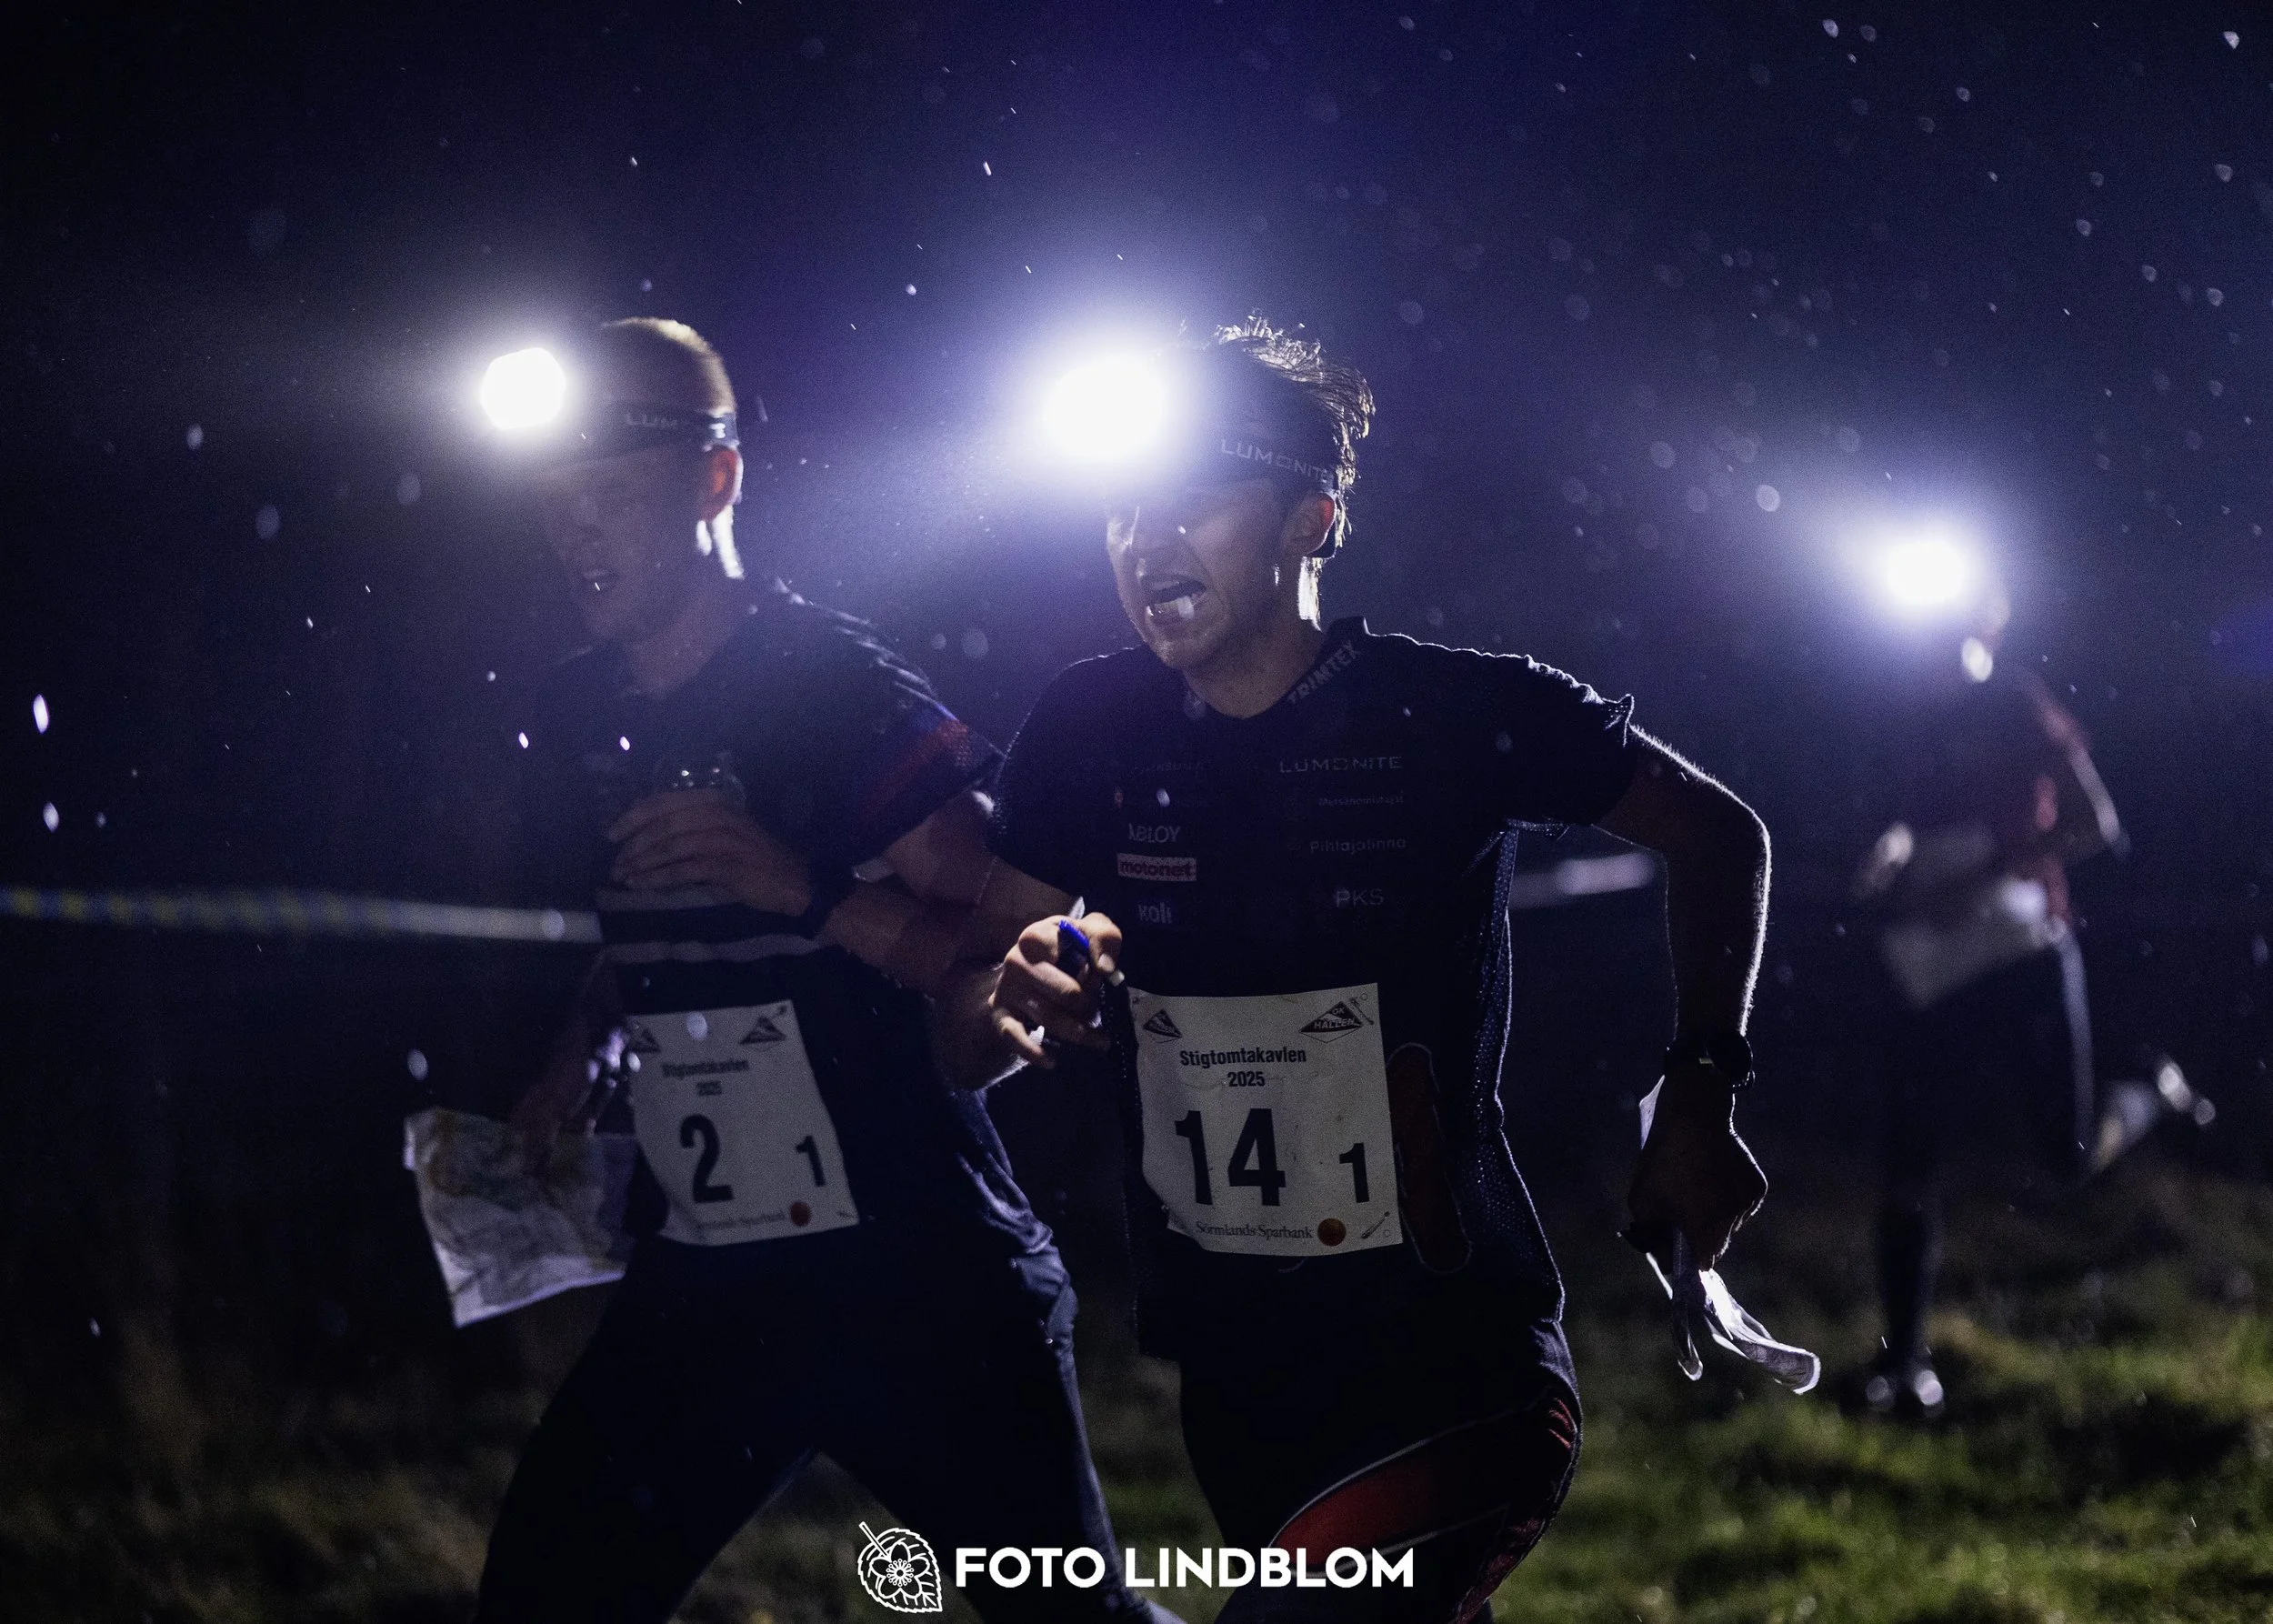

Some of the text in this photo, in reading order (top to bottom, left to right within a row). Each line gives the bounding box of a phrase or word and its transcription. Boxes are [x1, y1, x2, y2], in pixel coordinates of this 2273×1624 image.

[1278, 756, 1404, 774] LUMONITE
[1120, 860, 1192, 877] motonet
[1334, 887, 1386, 908] PKS
[1179, 1047, 1307, 1069] Stigtomtakavlen
[1227, 1071, 1266, 1088] 2025
[680, 1114, 734, 1204] 2
[796, 1136, 826, 1187] 1
[1174, 1108, 1287, 1207] 14
[1339, 1142, 1369, 1204] 1
[1257, 1224, 1314, 1241] Sparbank
